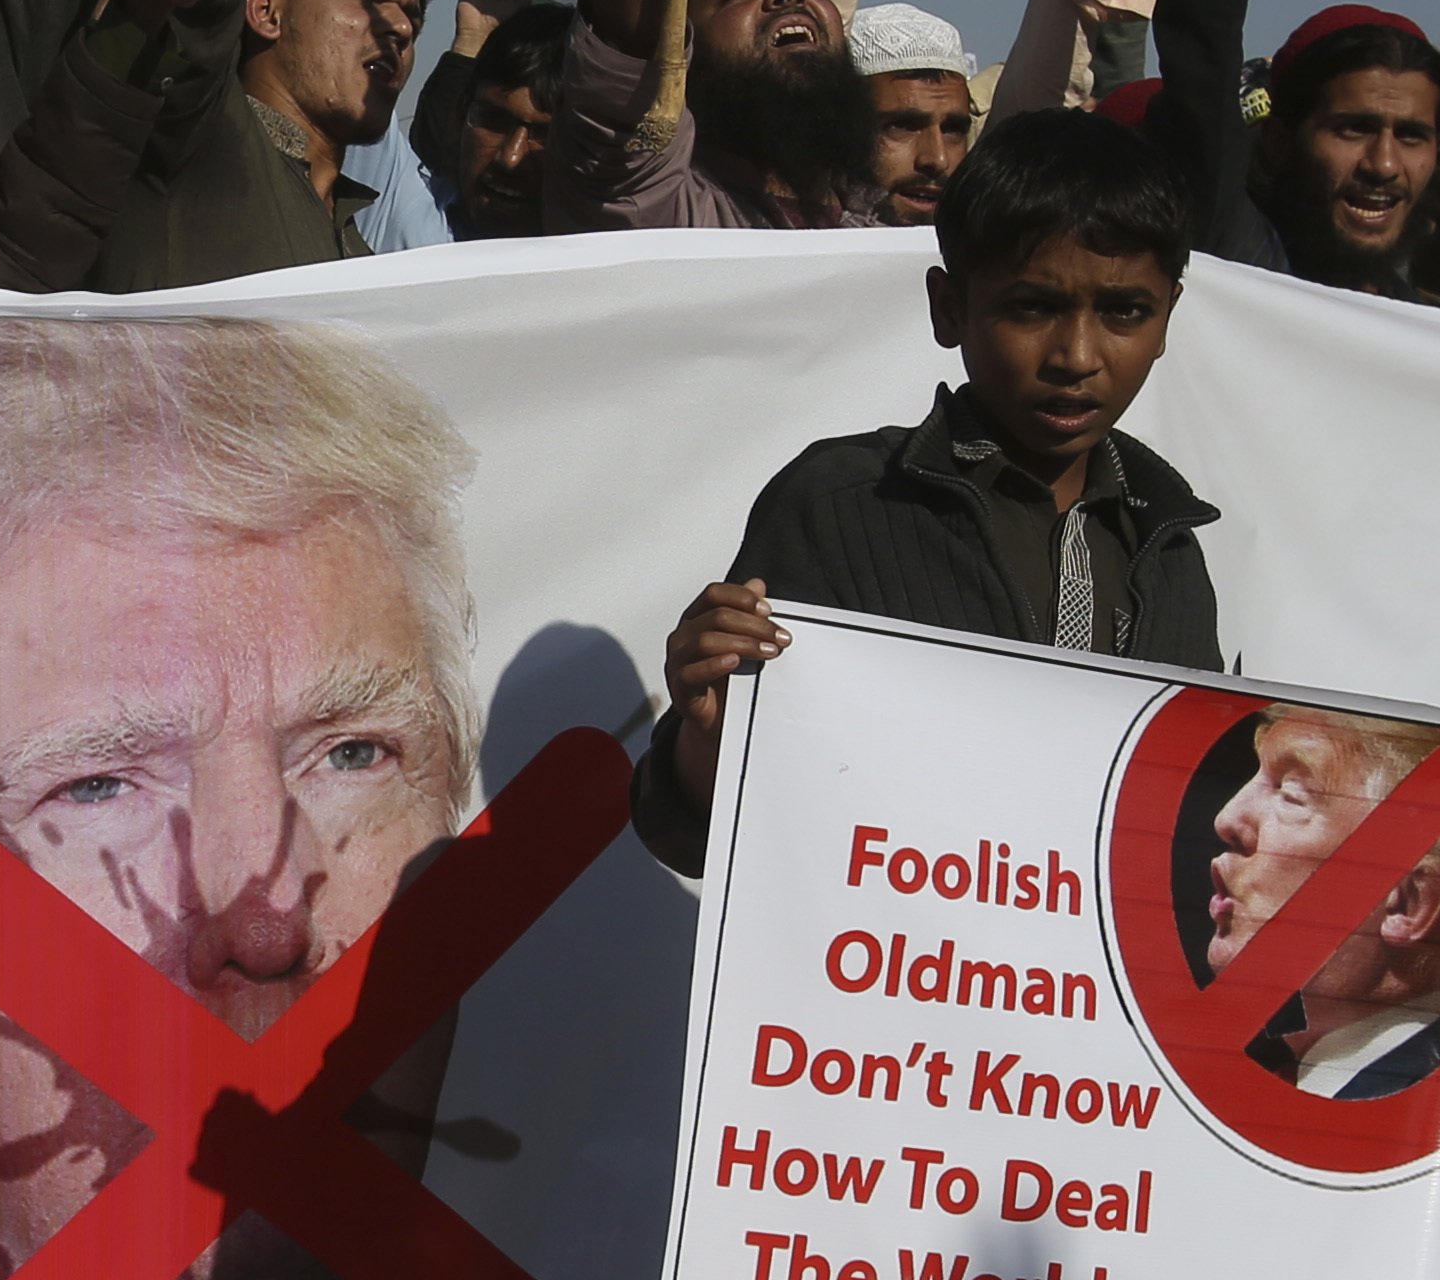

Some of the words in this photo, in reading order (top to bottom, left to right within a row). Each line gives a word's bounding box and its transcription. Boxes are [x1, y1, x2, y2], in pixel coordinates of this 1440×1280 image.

[849, 826, 1082, 916] Foolish
[826, 931, 1097, 1021] Oldman
[753, 1025, 954, 1108] Don’t
[970, 1051, 1161, 1129] Know
[718, 1126, 885, 1204] How
[902, 1148, 979, 1215] To
[1002, 1160, 1153, 1233] Deal
